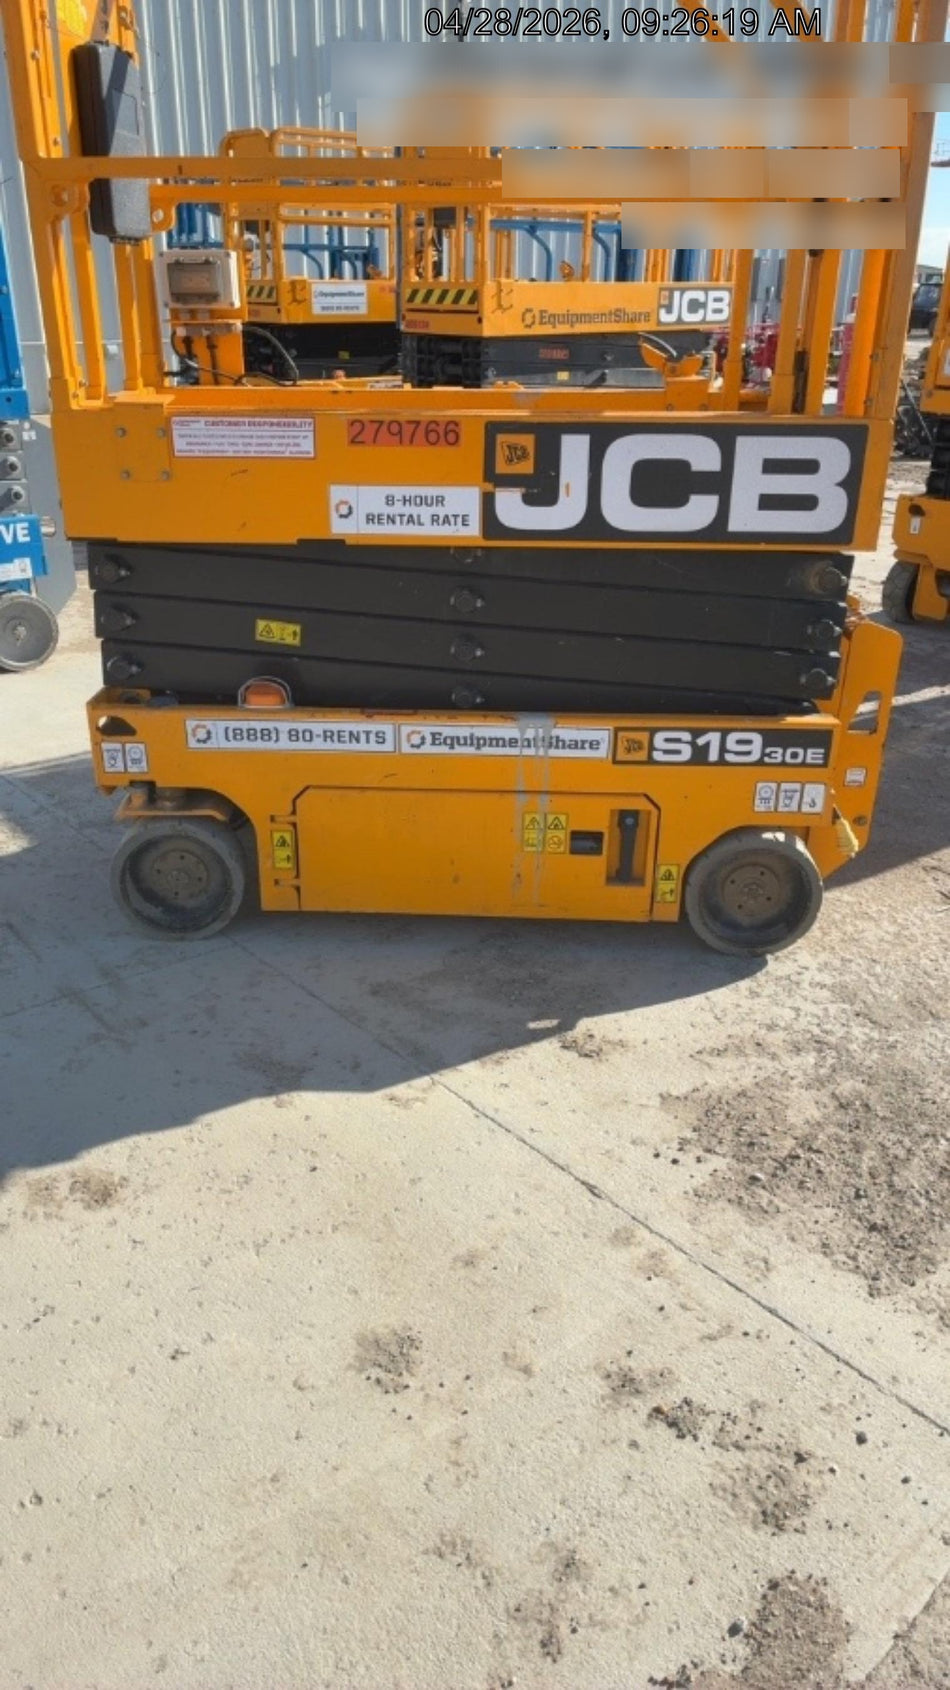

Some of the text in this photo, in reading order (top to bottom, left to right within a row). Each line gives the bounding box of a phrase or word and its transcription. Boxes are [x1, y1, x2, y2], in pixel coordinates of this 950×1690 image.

[659, 289, 731, 324] JCB
[538, 309, 651, 328] EquipmentShare
[350, 419, 461, 446] 279766
[495, 433, 851, 532] JCB
[384, 494, 446, 508] 8-HOUR
[365, 513, 471, 527] RENTAL RATE
[224, 726, 387, 745] (888) 80-RENTS
